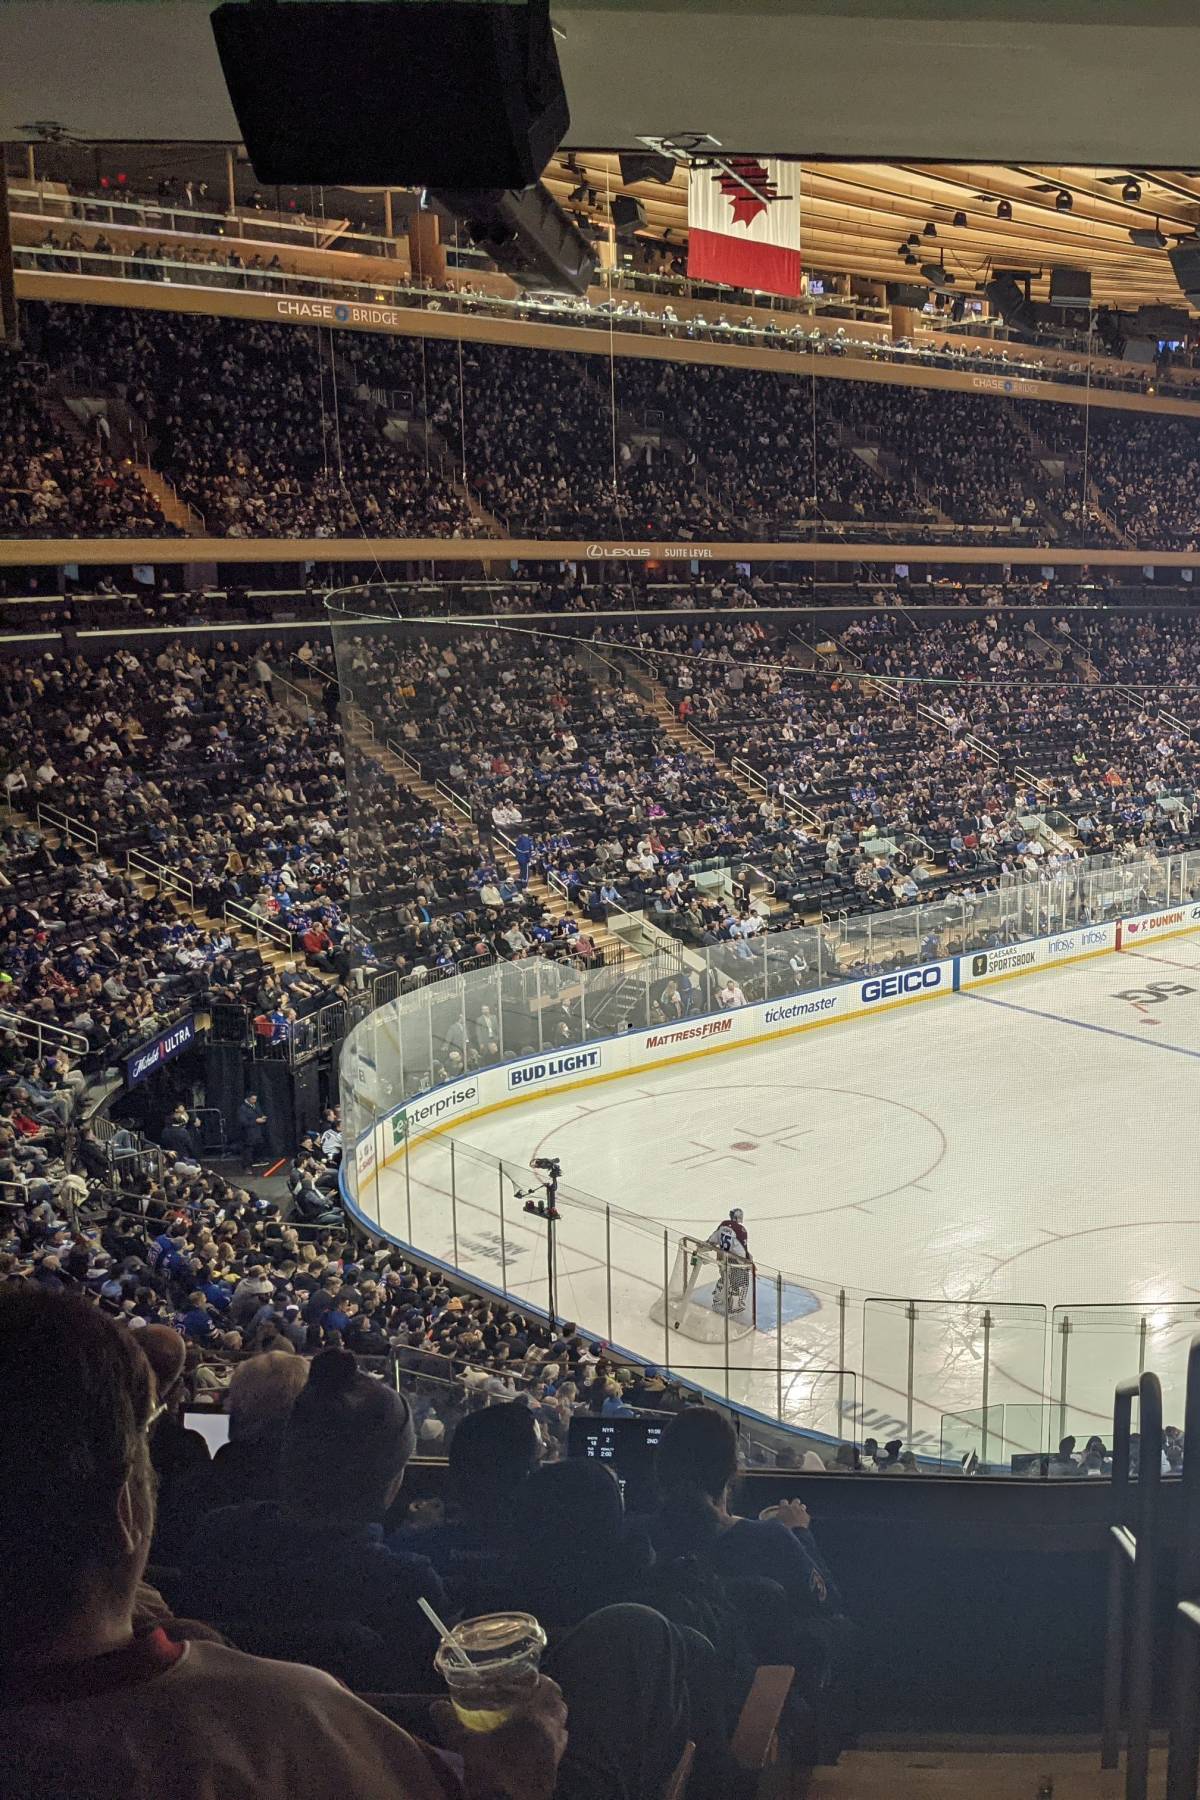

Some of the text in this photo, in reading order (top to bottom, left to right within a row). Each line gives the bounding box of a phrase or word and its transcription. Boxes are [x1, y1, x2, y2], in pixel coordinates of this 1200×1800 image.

[277, 301, 399, 325] CHASE BRIDGE
[973, 378, 1003, 390] CHASE
[604, 549, 712, 558] LEXUS SUITE LEVEL
[1149, 910, 1185, 929] DUNKIN'
[989, 946, 1017, 960] CAESARS
[989, 952, 1036, 973] SPORTSBOOK
[860, 966, 941, 1002] GEICO
[764, 996, 837, 1023] ticketmaster
[164, 1025, 191, 1053] ULTRA
[511, 1051, 598, 1086] BUD LIGHT
[393, 1085, 476, 1133] enterprise
